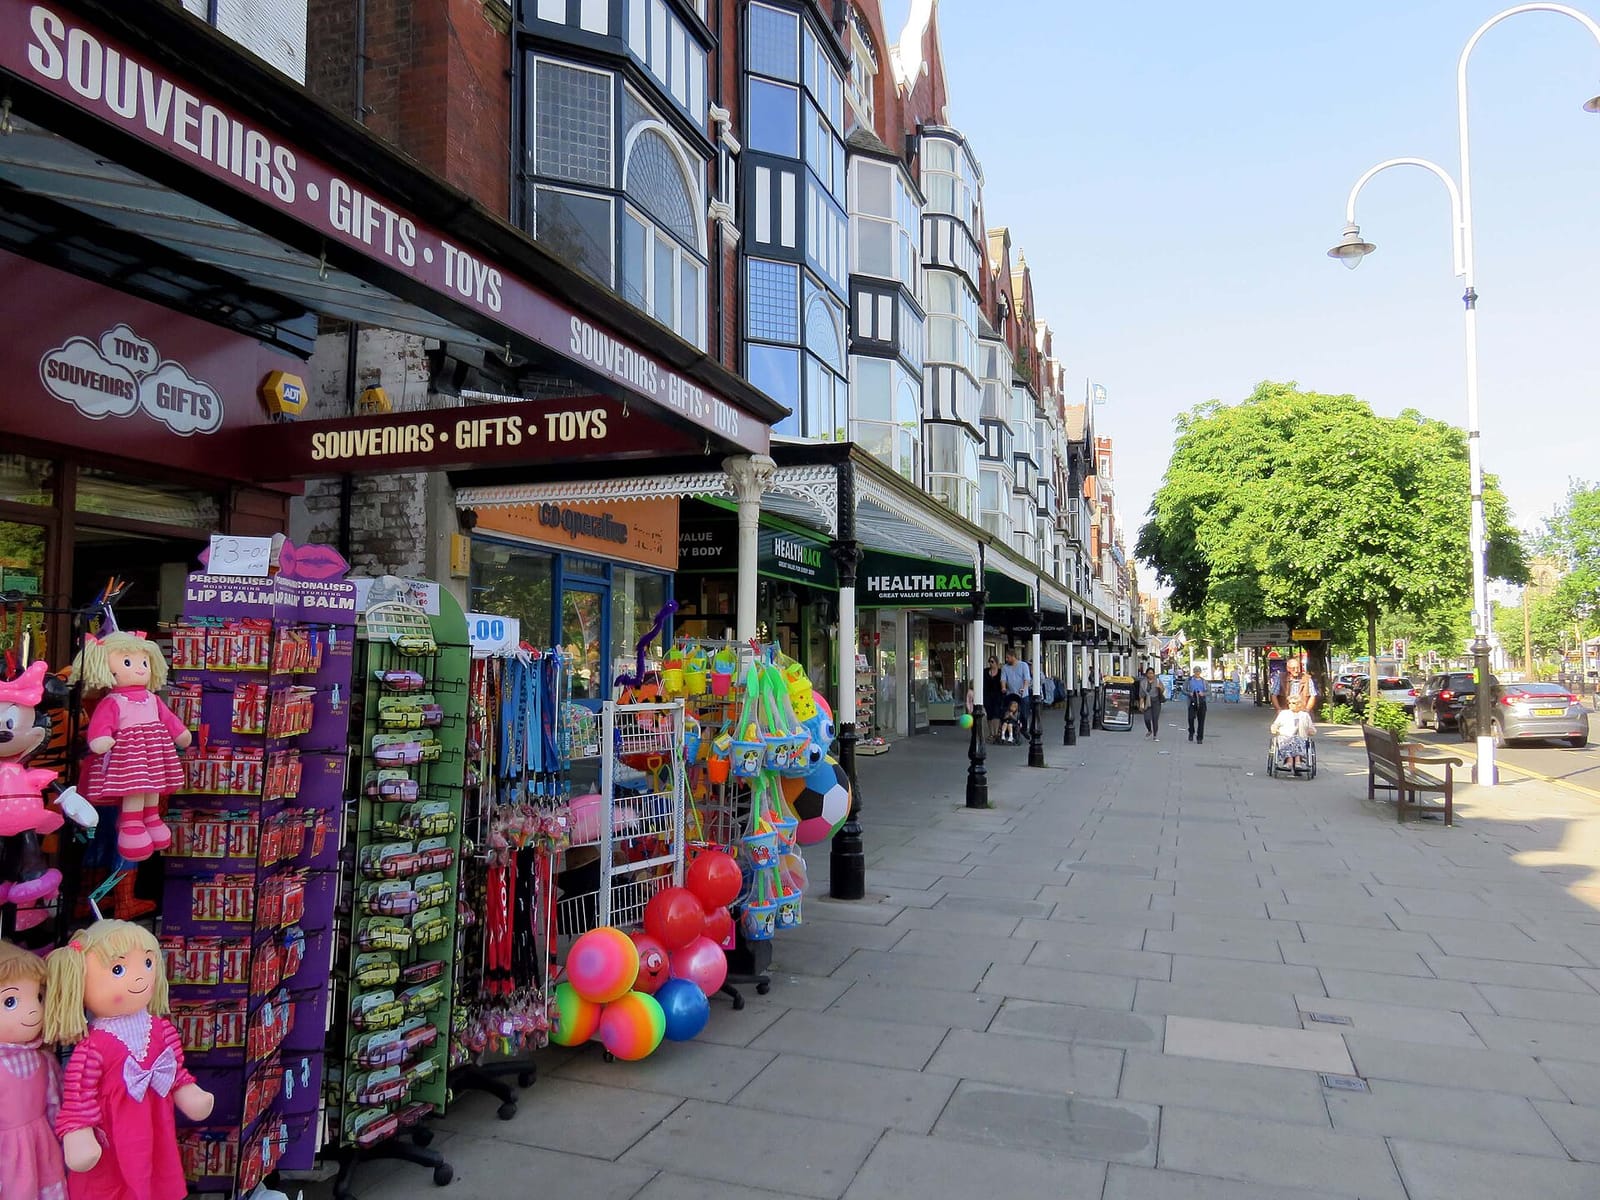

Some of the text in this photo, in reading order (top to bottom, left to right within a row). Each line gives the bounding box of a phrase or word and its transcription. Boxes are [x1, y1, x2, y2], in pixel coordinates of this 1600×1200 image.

[28, 5, 502, 312] SOUVENIRS GIFTS TOYS
[114, 337, 150, 364] TOYS
[47, 358, 134, 400] SOUVENIRS
[570, 316, 738, 438] SOUVENIRS GIFTS TOYS
[156, 382, 212, 420] GIFTS
[284, 387, 300, 402] ADT
[311, 408, 608, 460] SOUVENIRS GIFTS TOYS
[692, 546, 723, 556] BODY
[775, 538, 822, 568] HEALTHRACK
[190, 574, 274, 586] PERSONALISED
[868, 574, 972, 591] HEALTHRAC
[188, 588, 275, 604] LIP BALM
[303, 596, 354, 609] BALM
